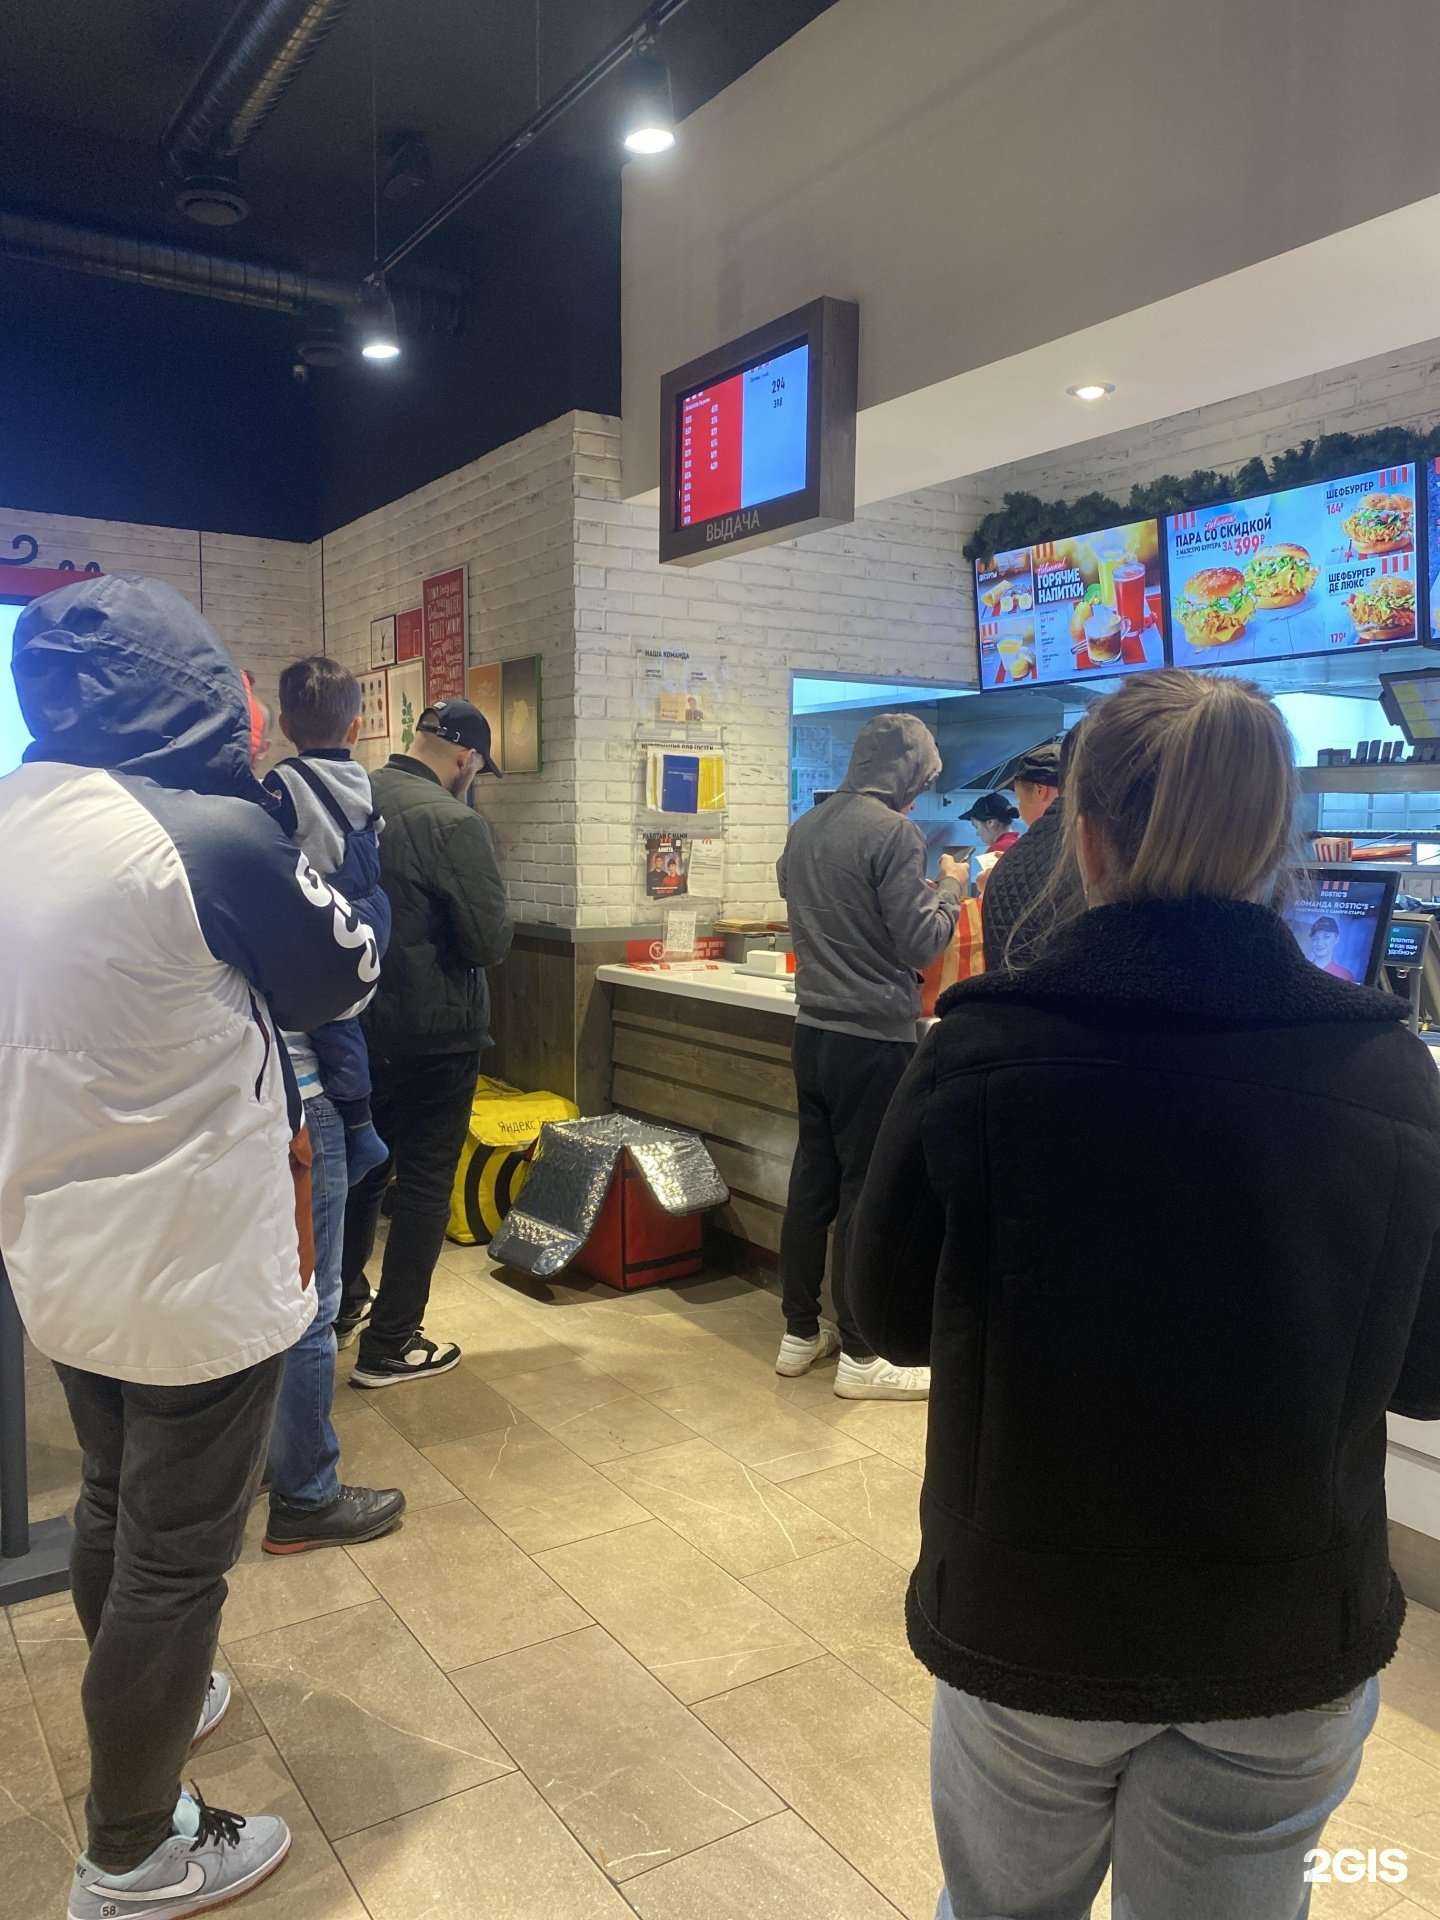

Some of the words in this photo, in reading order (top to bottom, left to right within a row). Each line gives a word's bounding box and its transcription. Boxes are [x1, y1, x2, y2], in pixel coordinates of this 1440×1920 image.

[1326, 481, 1374, 499] ШЕФБУРГЕР
[706, 509, 760, 542] ВЫДАЧА
[1175, 532, 1202, 547] ПАРА
[1204, 528, 1217, 541] СО
[1220, 512, 1272, 538] СКИДКОЙ
[1037, 568, 1081, 588] ГОРЯЧИЕ
[1328, 567, 1376, 583] ШЕФБУРГЕР
[1038, 582, 1084, 603] НАПИТКИ
[1328, 581, 1340, 594] ДЕ
[1340, 578, 1365, 592] ЛЮКС
[663, 650, 689, 660] КОМАНДА
[497, 1120, 537, 1133] Яндекс
[102, 1905, 116, 1917] 58
